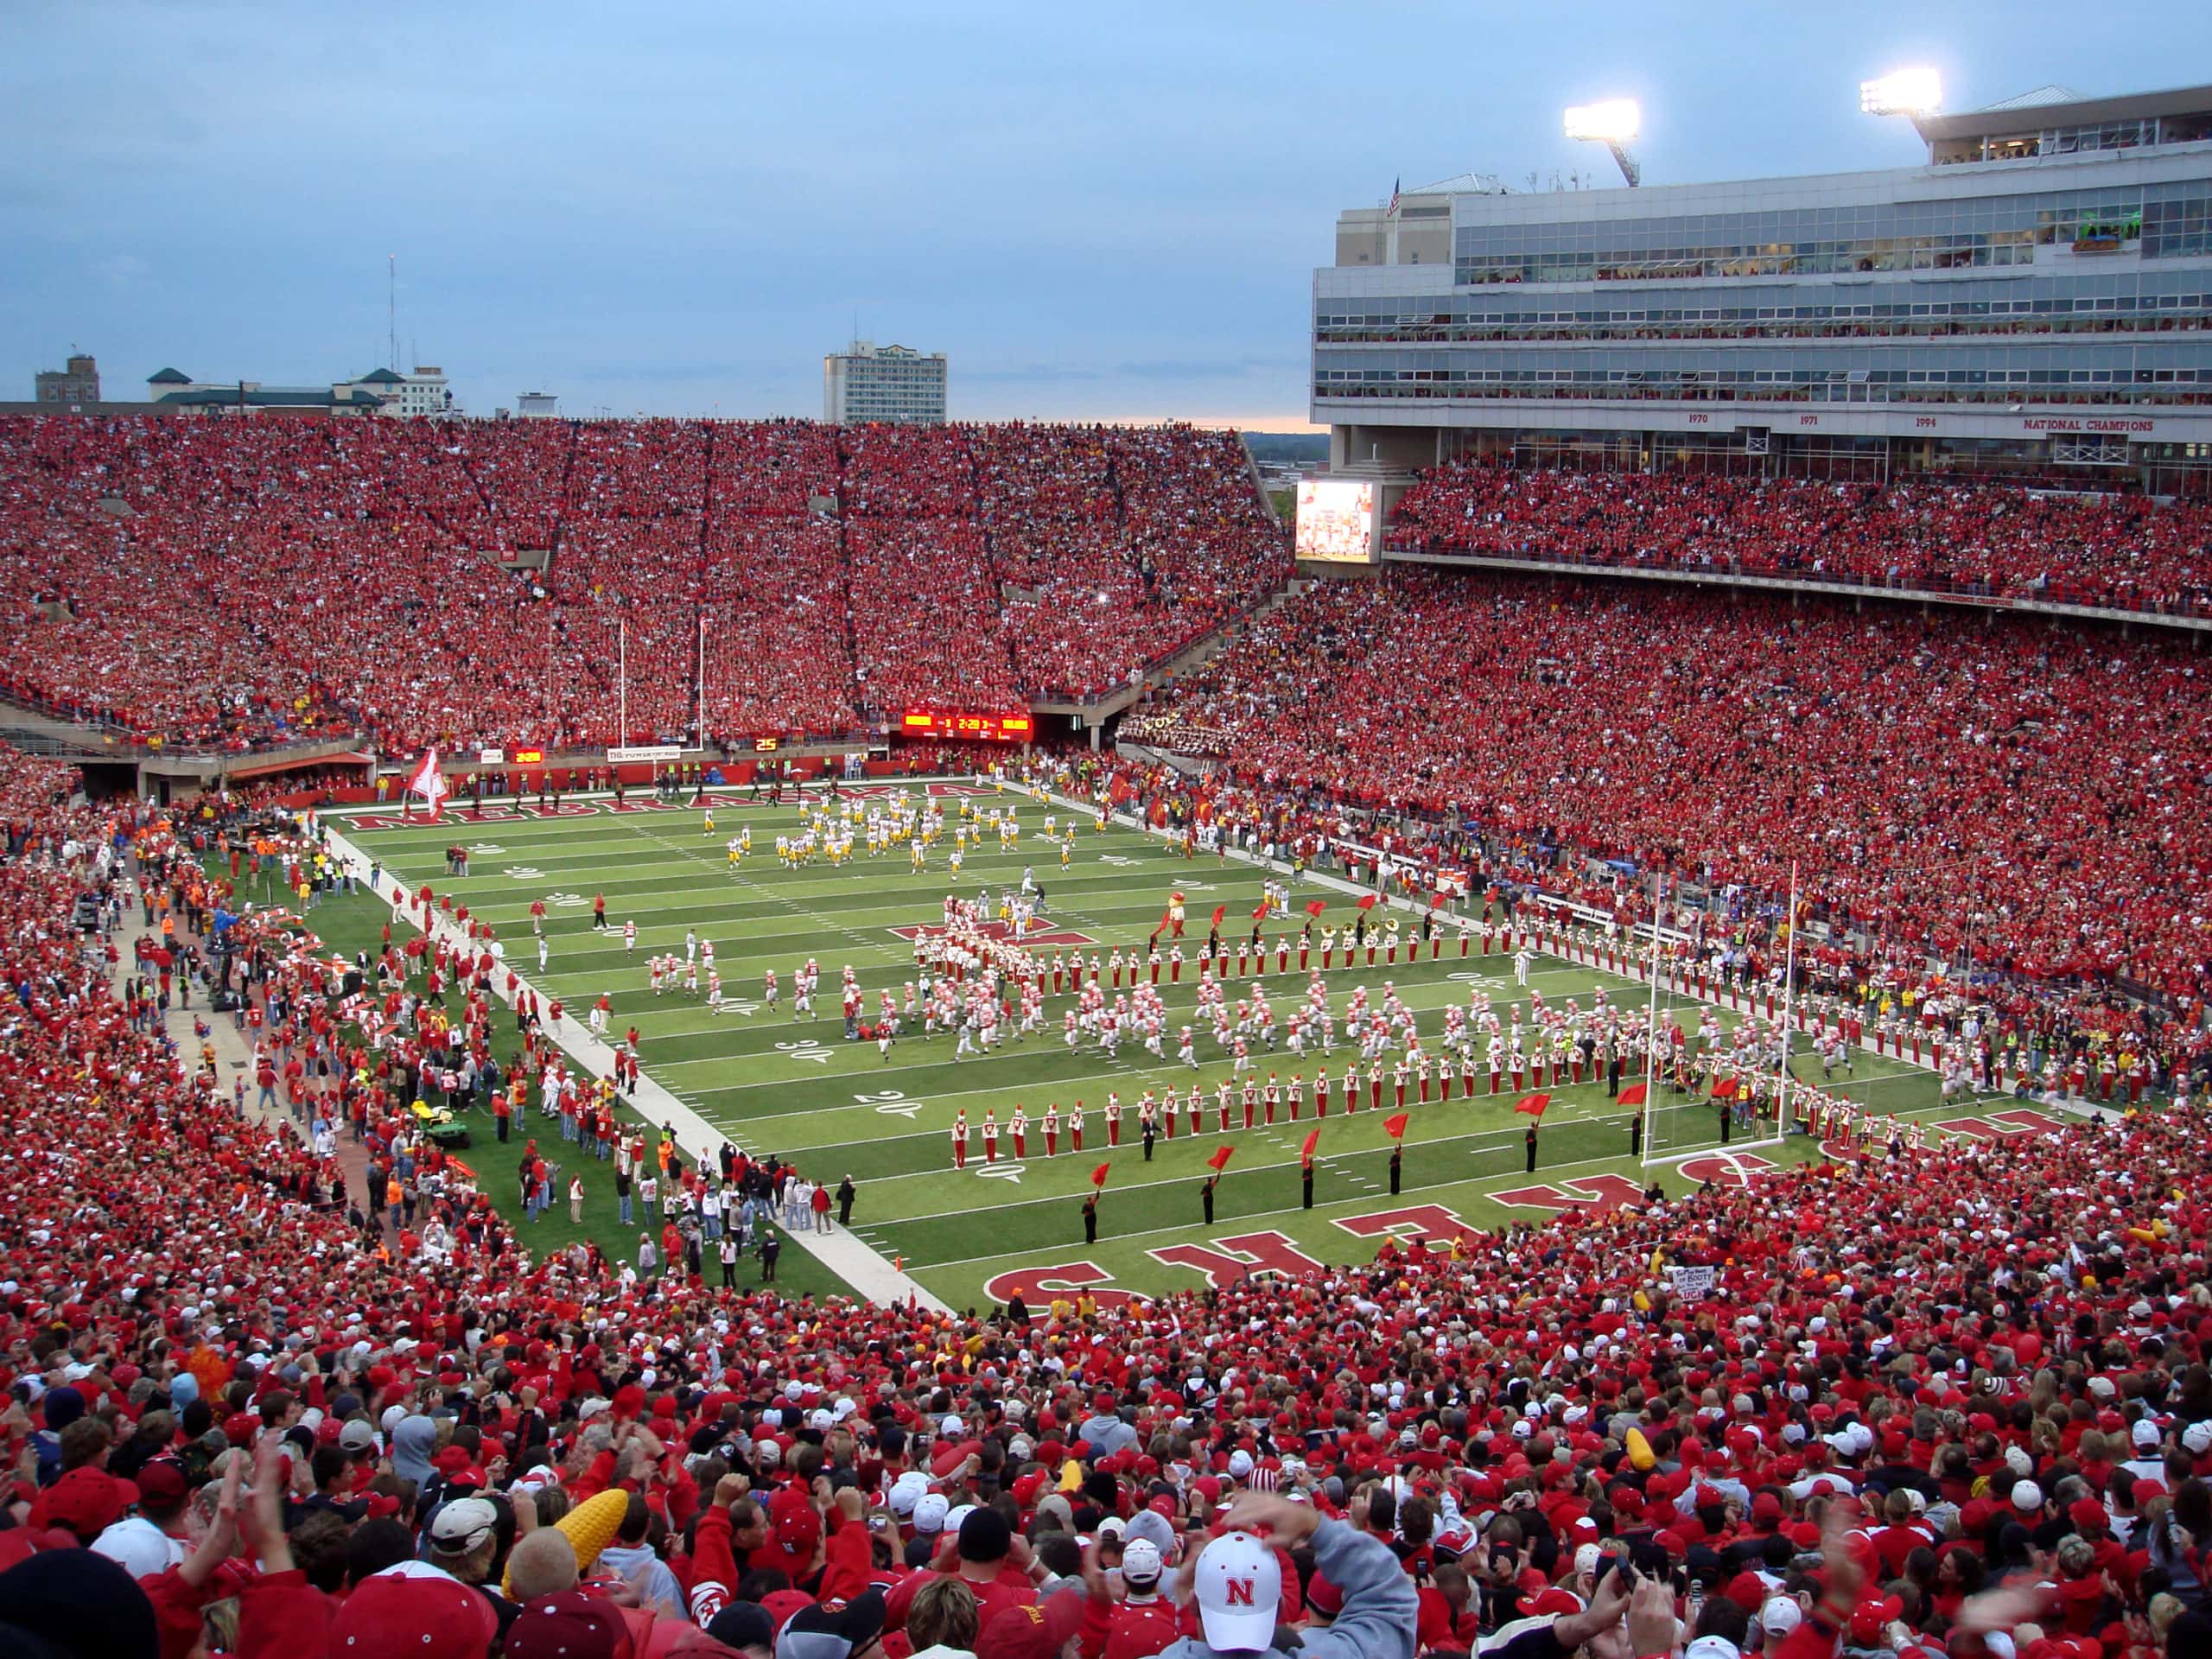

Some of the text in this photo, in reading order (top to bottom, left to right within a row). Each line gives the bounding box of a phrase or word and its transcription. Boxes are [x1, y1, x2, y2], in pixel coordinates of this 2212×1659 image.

[1689, 414, 1708, 423] 1970
[1800, 416, 1818, 425] 1971
[1916, 417, 1936, 428] 1994
[2024, 419, 2153, 431] NATIONAL CHAMPIONS
[756, 739, 777, 750] 25
[340, 780, 996, 831] NEBRASKA
[854, 1090, 922, 1114] 20
[1225, 1577, 1255, 1606] N
